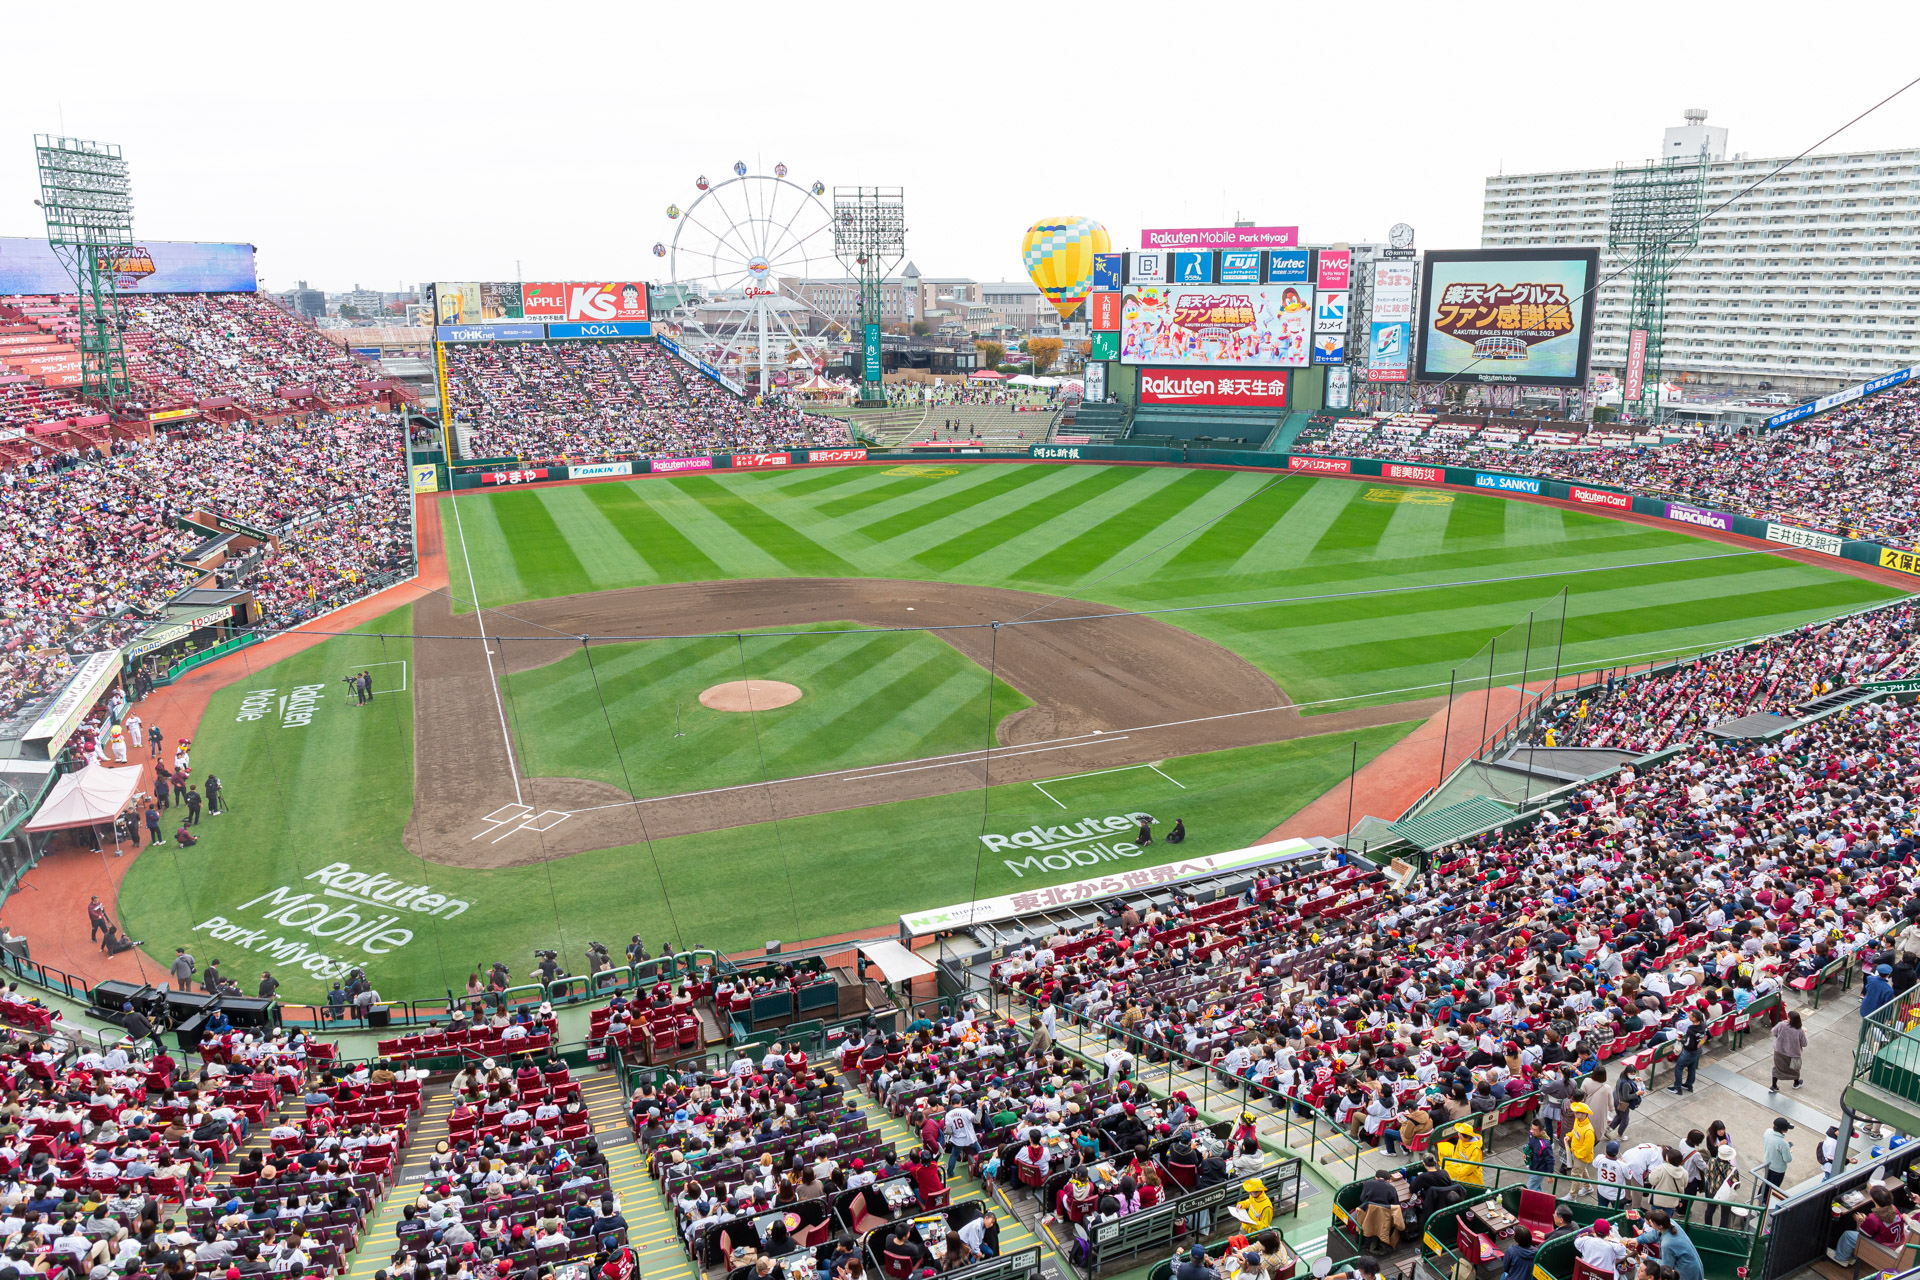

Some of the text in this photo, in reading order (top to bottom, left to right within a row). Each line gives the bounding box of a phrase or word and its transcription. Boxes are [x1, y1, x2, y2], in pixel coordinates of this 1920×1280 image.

[1150, 231, 1288, 244] Rakuten Mobile Park Miyagi
[1224, 254, 1258, 270] Fuji
[1272, 258, 1305, 268] Yurtec
[1320, 258, 1348, 270] TWG
[1376, 269, 1412, 286] まるまつ
[483, 284, 520, 296] 三菱地所と
[745, 287, 775, 299] Glico
[1444, 285, 1566, 304] 楽天イーグルス
[484, 296, 520, 305] 次にいこう。
[526, 297, 563, 307] APPLE
[568, 284, 617, 320] K's
[1178, 296, 1251, 307] 楽天イーグルス
[1374, 304, 1409, 312] かに政宗
[1102, 295, 1111, 328] 大和証券
[1175, 308, 1256, 323] ファン感謝祭
[1436, 304, 1572, 330] ファン感謝祭
[581, 326, 619, 335] NOKIA
[1319, 322, 1342, 330] カメイ
[1628, 332, 1642, 398] 三井のリハウス
[1142, 376, 1285, 396] Rakuten 楽天生命
[1874, 372, 1908, 389] 東北ボール
[1828, 390, 1861, 405] 東北ボール
[1779, 406, 1813, 422] 東北ボール
[754, 454, 772, 465] グー
[809, 451, 866, 462] 東京インテリア
[1033, 447, 1080, 458] 河北新報
[582, 466, 614, 475] DAIKIN
[654, 459, 710, 469] Rakuten Mobile
[1302, 461, 1346, 471] アイリスオーヤマ
[494, 470, 536, 485] やまや
[1391, 466, 1435, 481] 能美防災
[1477, 476, 1539, 492] 山九 SANKYU
[1575, 490, 1626, 506] Rakuten Card
[1770, 527, 1838, 553] 三井住友銀行
[235, 689, 277, 722] Mobile
[282, 684, 325, 728] Rakuten
[979, 812, 1160, 852] Rakuten
[1003, 841, 1144, 878] Mobile
[304, 862, 470, 920] Rakuten
[1010, 858, 1218, 913] 東北から世界へ!
[237, 886, 414, 954] Mobile
[910, 914, 952, 927] NX
[192, 916, 369, 980] Park Miyagi
[1242, 1057, 1248, 1066] 5
[740, 1066, 751, 1075] 33
[1268, 1065, 1278, 1076] 25
[953, 1118, 964, 1130] 18
[603, 1136, 628, 1145] PRESTIGE
[1638, 1141, 1651, 1150] 7
[1601, 1168, 1617, 1182] 33
[1891, 1225, 1900, 1243] 7
